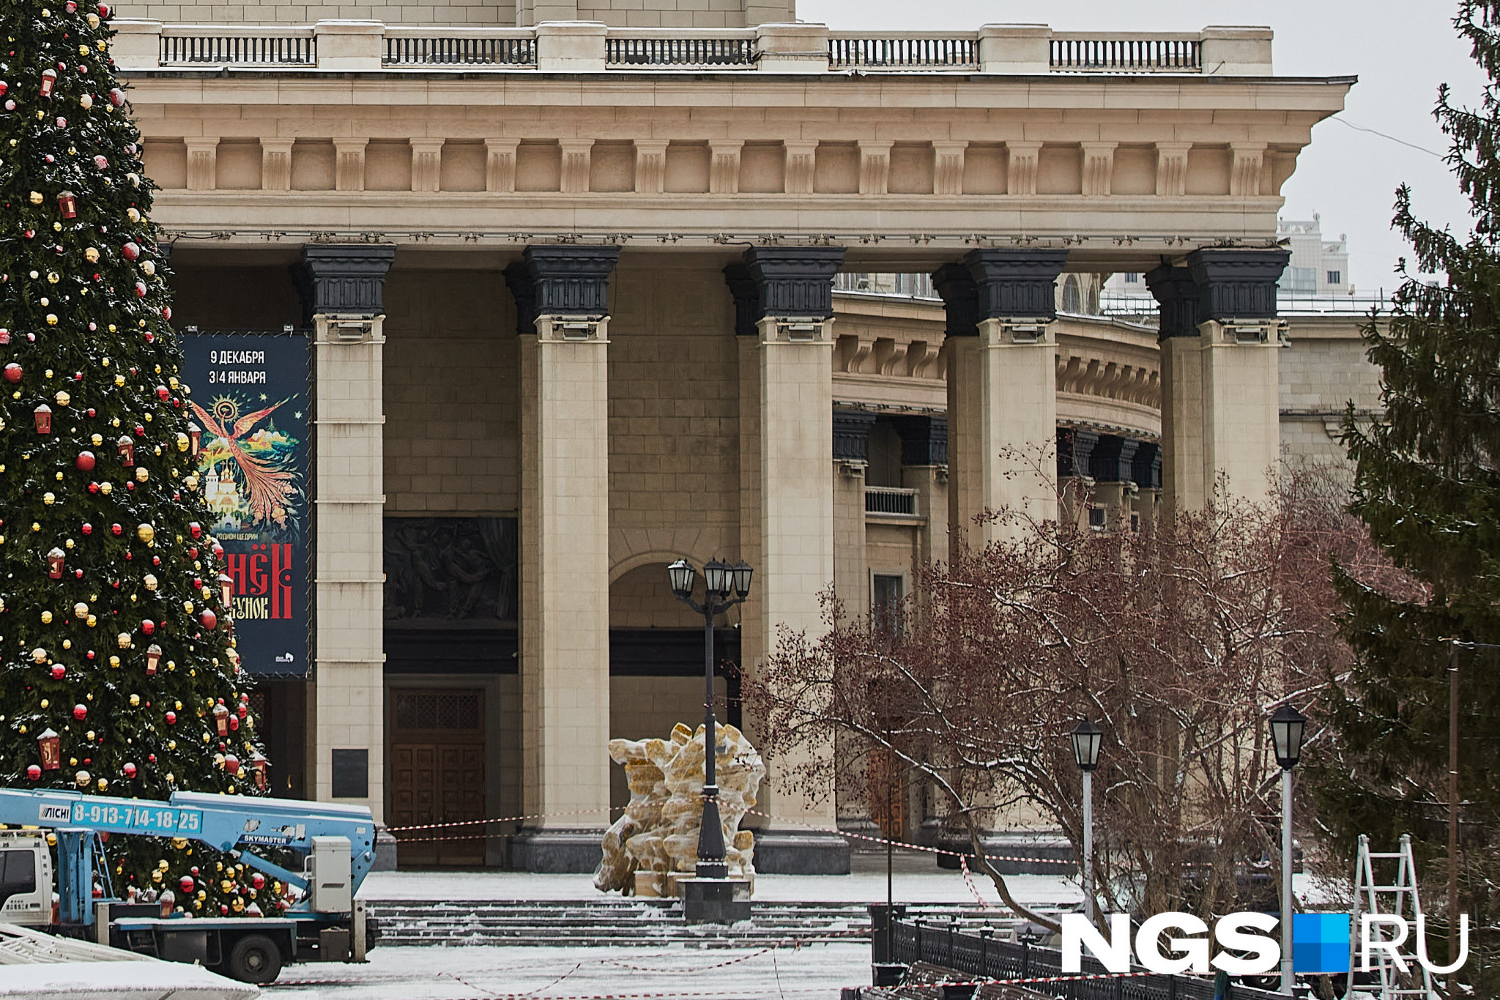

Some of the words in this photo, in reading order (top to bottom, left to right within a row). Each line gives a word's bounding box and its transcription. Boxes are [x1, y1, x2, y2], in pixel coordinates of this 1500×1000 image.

[210, 350, 218, 364] 9
[219, 350, 265, 365] ДЕКАБРЯ
[228, 370, 266, 384] ЯНВАРЯ
[227, 543, 293, 619] НЁК
[73, 805, 199, 830] 8-913-714-18-25
[244, 835, 287, 844] SKYMASTER
